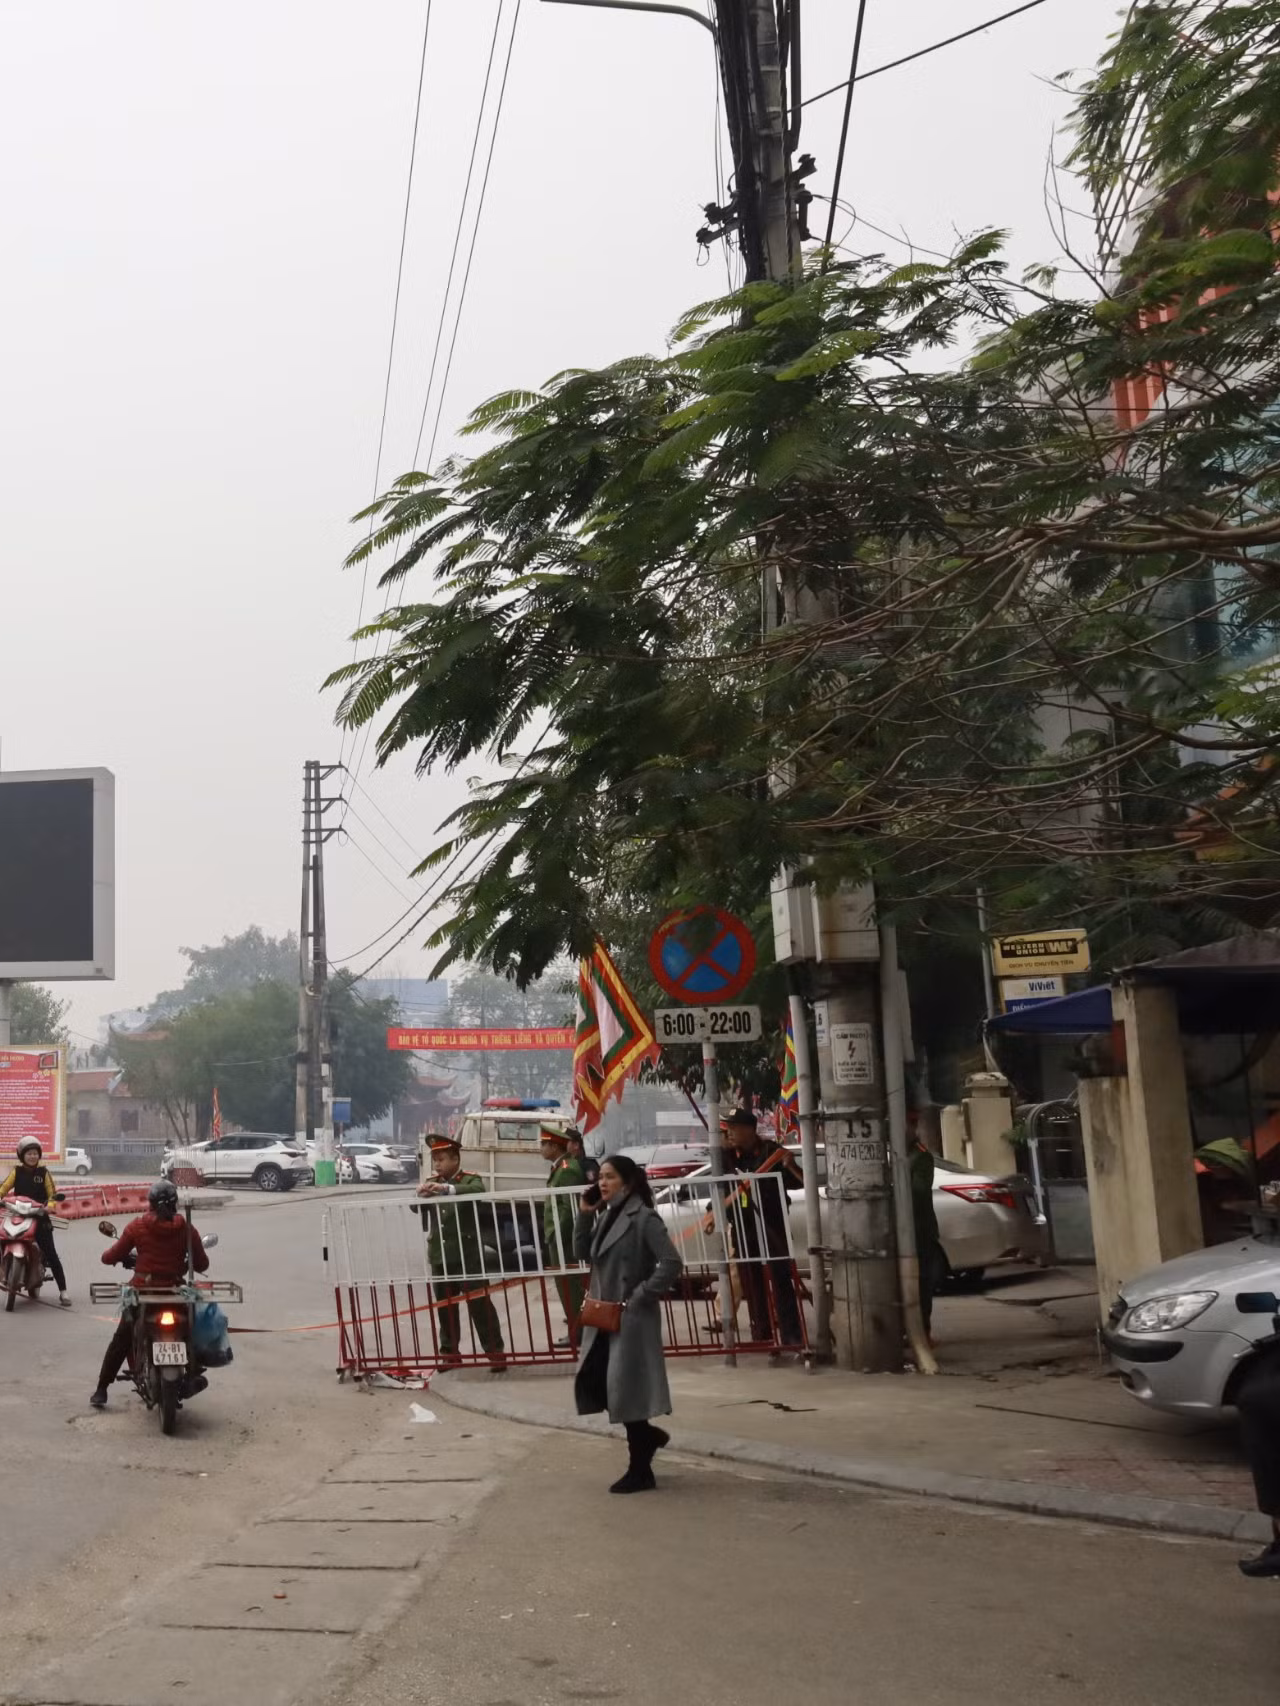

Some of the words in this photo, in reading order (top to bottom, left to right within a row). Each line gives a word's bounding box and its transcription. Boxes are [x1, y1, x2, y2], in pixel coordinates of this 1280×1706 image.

[663, 1013, 695, 1037] 6:00
[710, 1011, 752, 1035] 22:00
[846, 1119, 872, 1138] 15
[841, 1144, 857, 1160] 474
